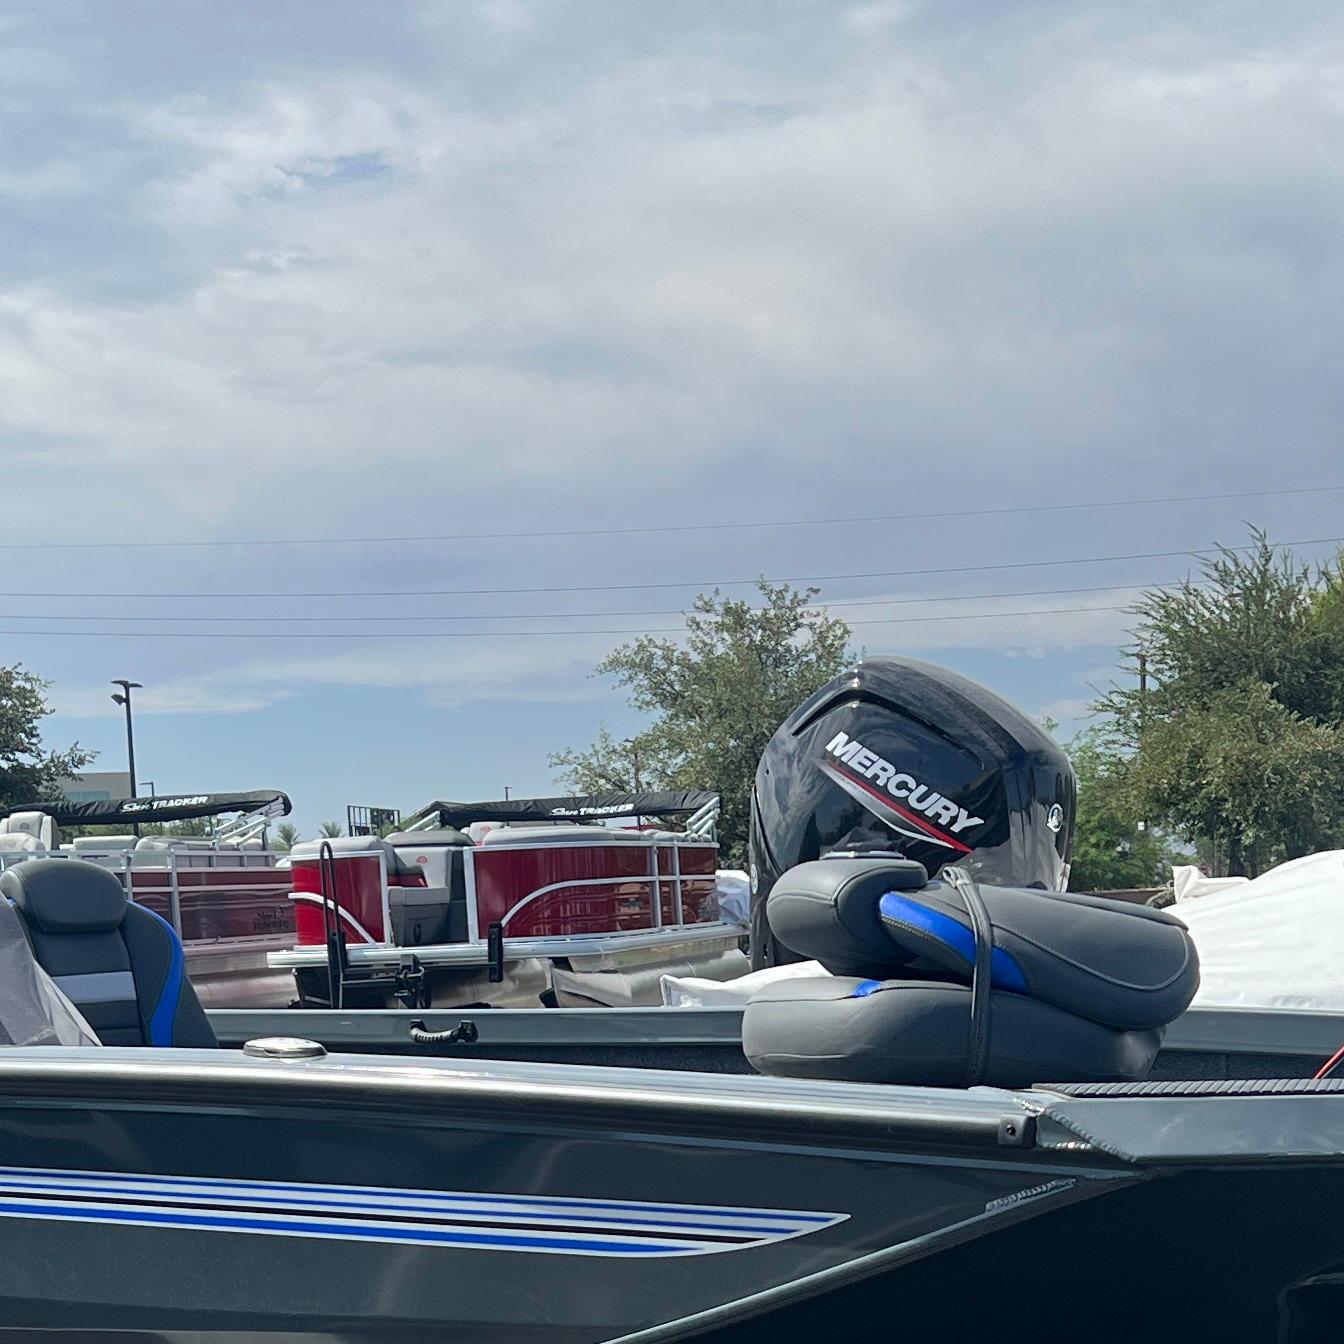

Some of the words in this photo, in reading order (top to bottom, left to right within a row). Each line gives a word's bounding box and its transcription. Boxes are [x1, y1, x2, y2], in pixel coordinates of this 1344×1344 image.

[825, 731, 985, 833] MERCURY
[152, 796, 208, 810] TRACKER
[579, 803, 635, 816] TRACKER
